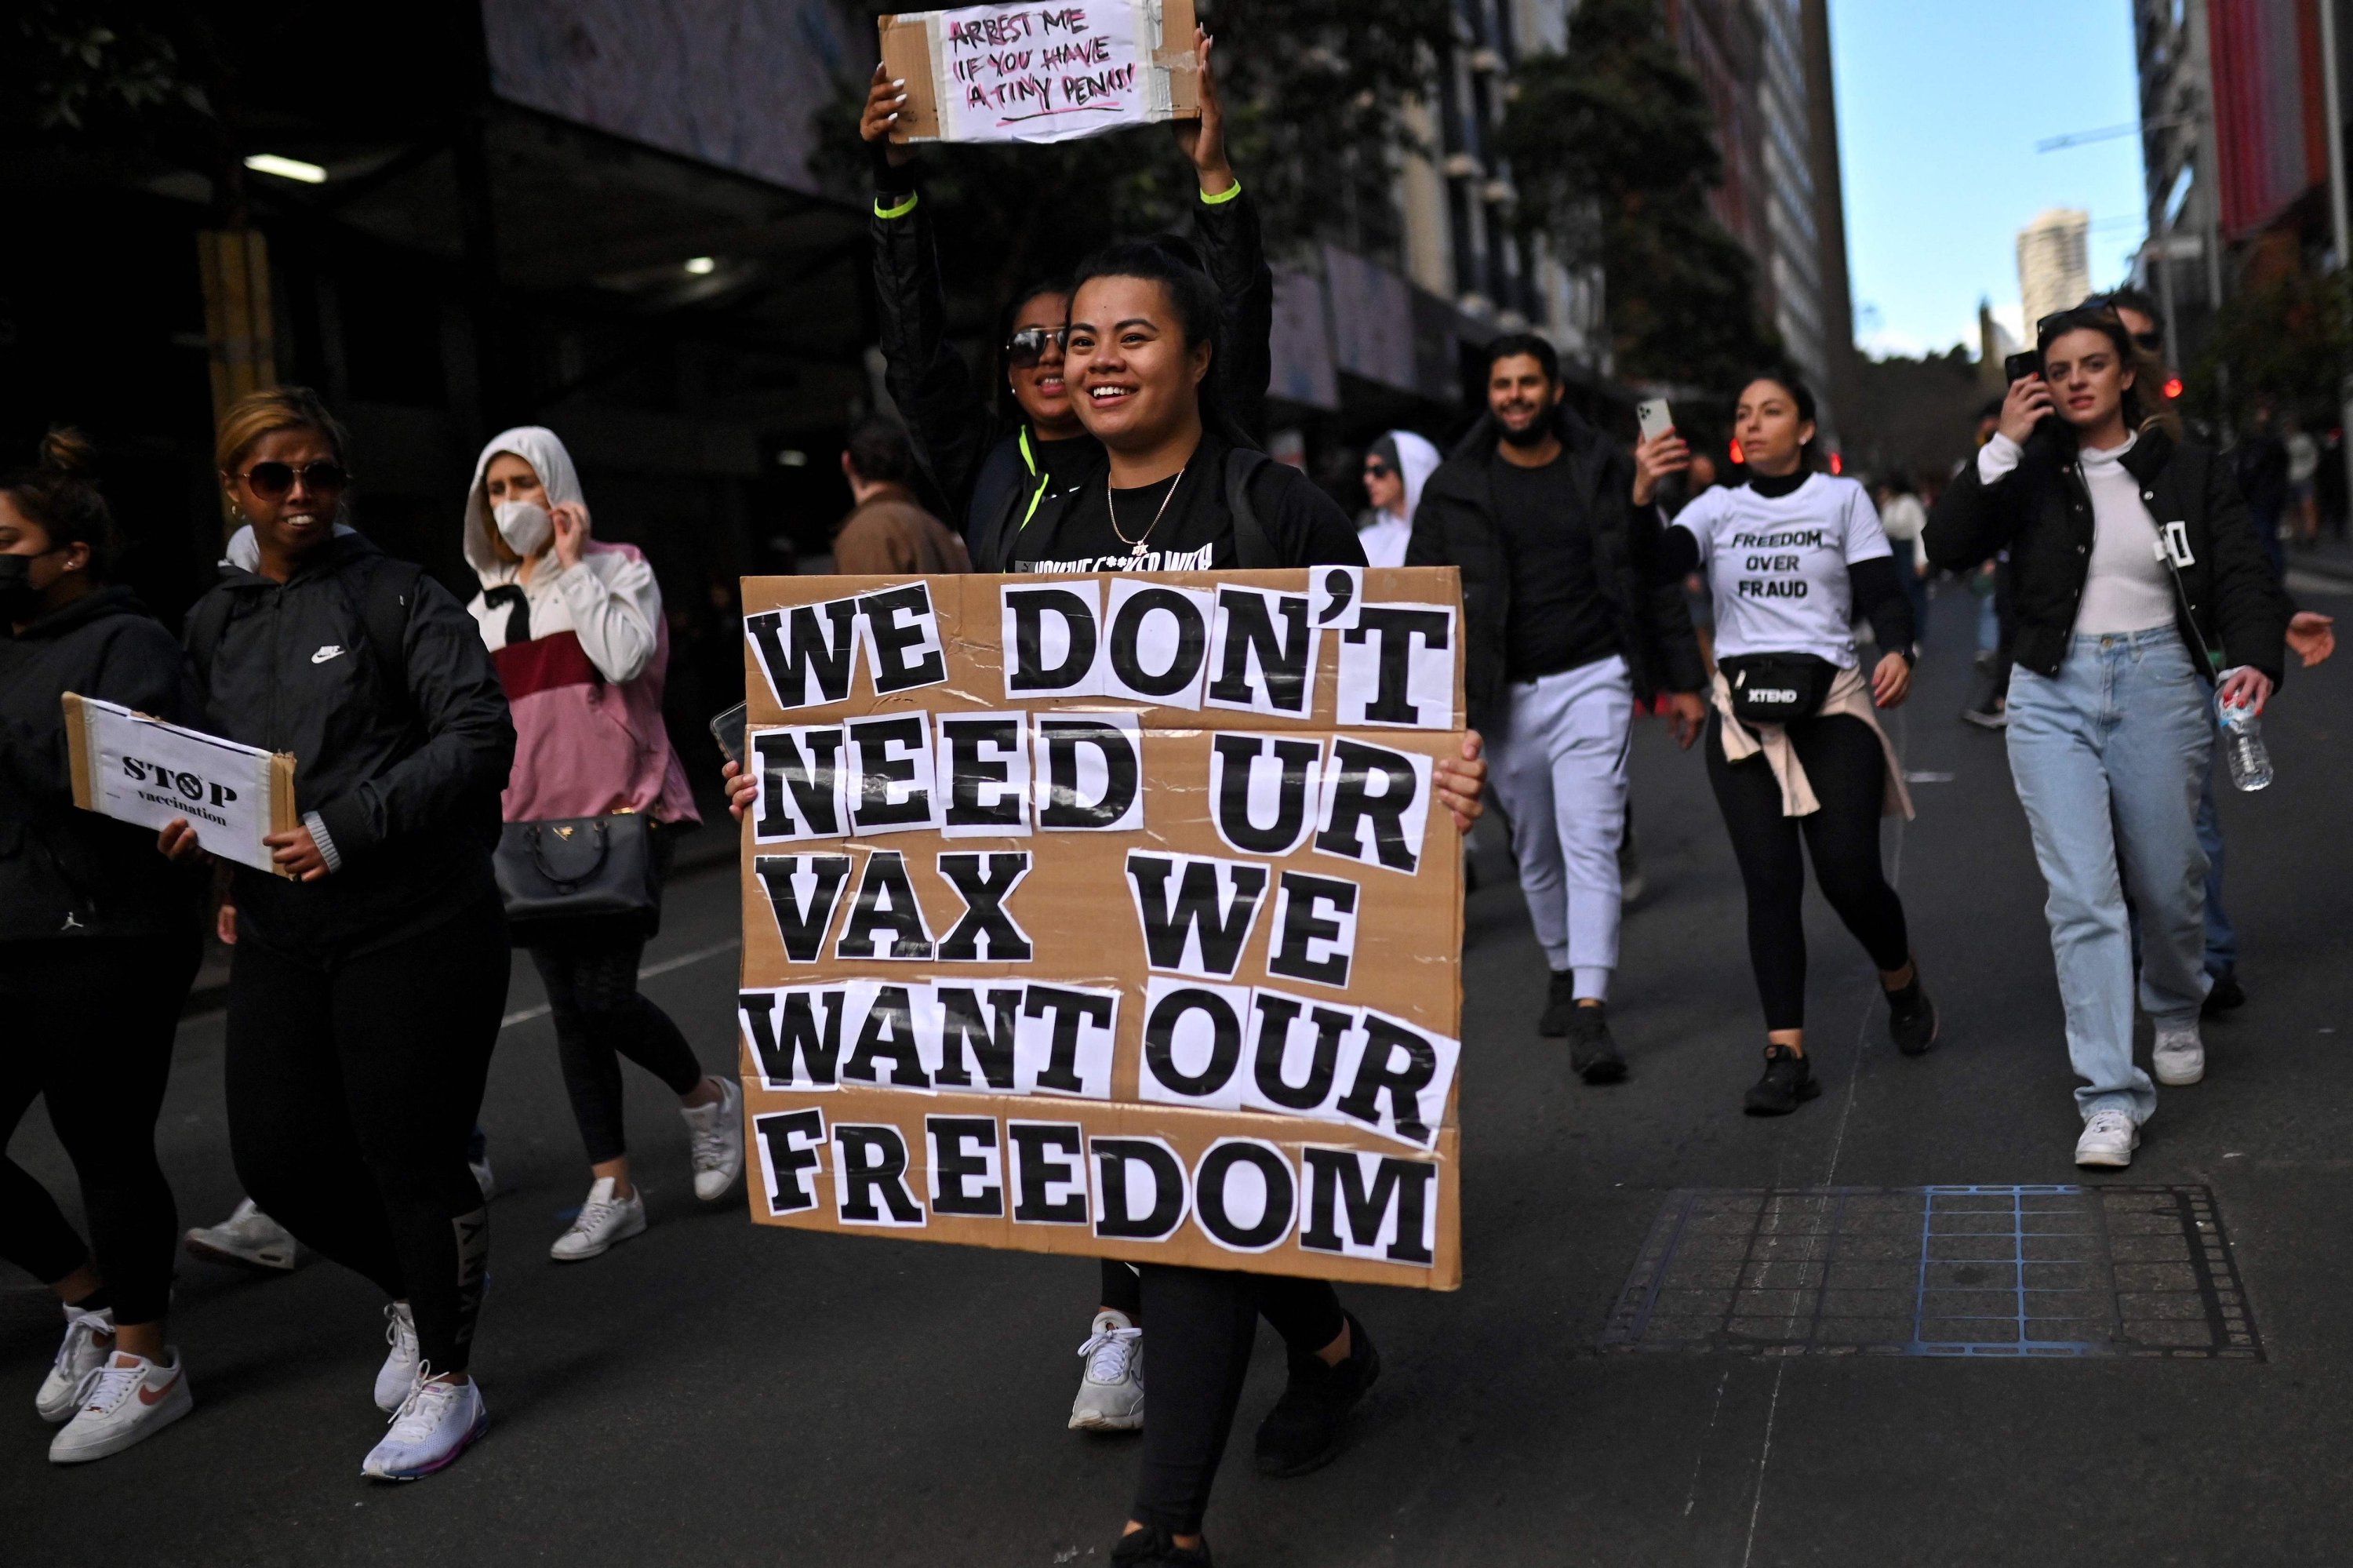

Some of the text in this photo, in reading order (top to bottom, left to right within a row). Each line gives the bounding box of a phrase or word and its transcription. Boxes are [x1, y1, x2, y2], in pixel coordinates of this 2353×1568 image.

[949, 8, 1089, 55] ARREST ME
[953, 36, 1111, 83] IF YOU HAVE
[966, 62, 1136, 111] A TINY PENIS!
[1732, 529, 1822, 548] FREEDOM
[1746, 554, 1800, 572] OVER
[1738, 579, 1808, 598] FRAUD
[748, 569, 1449, 725] WE DON'T
[1748, 689, 1798, 704] XTEND
[122, 755, 238, 809] STOP
[755, 718, 1418, 874] NEED UR
[137, 789, 227, 827] vaccination
[755, 853, 1358, 986] VAX WE
[740, 985, 1438, 1149] WANT OUR
[757, 1110, 1436, 1264] FREEDOM
